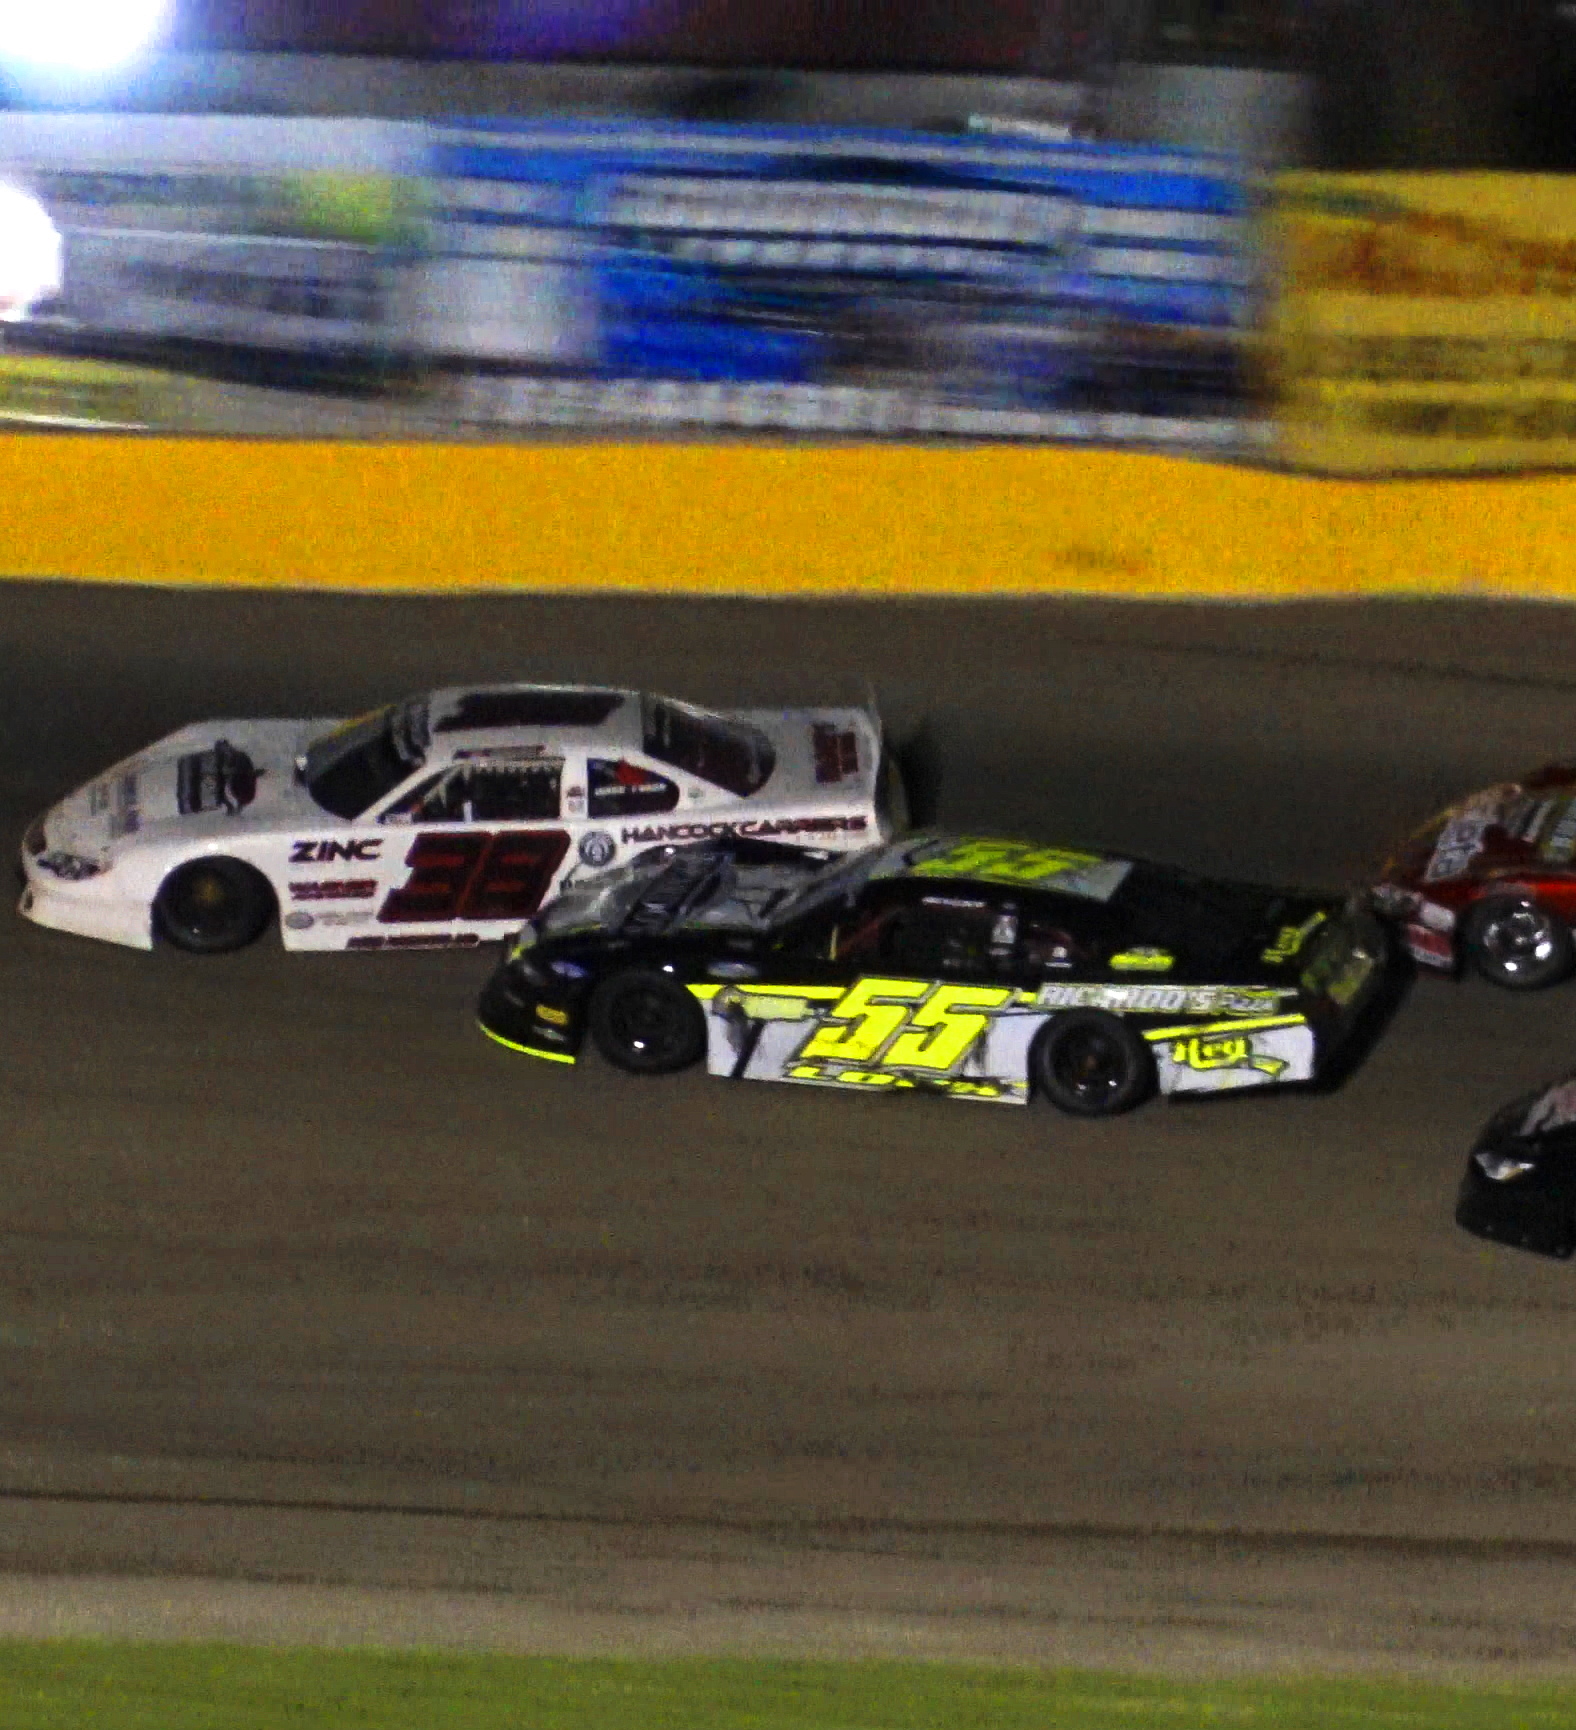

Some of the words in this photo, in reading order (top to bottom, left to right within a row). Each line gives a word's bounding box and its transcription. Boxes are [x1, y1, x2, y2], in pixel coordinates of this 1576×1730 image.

[288, 838, 383, 863] ZINC
[621, 821, 741, 845] HANCOCK
[377, 830, 568, 923] 38
[797, 976, 1012, 1070] 55
